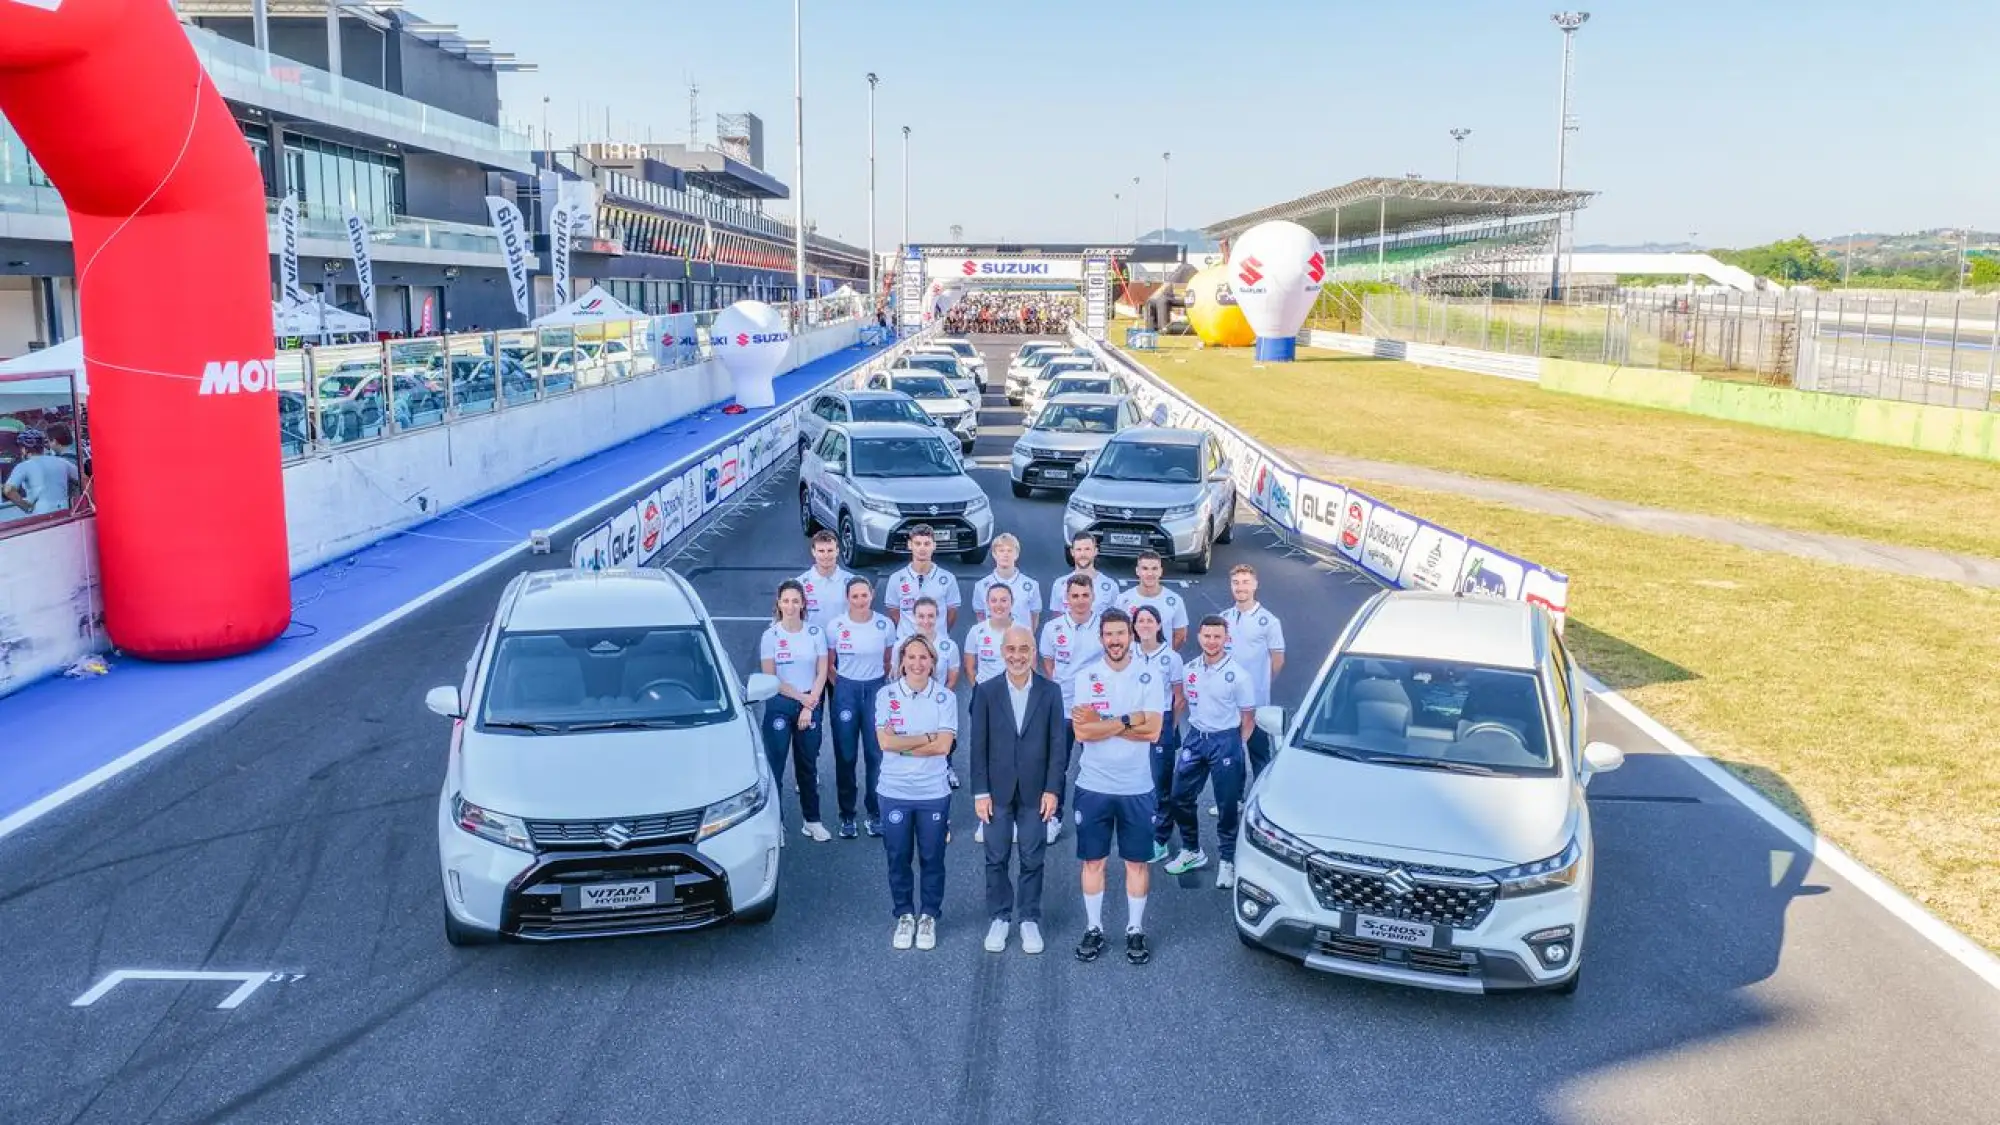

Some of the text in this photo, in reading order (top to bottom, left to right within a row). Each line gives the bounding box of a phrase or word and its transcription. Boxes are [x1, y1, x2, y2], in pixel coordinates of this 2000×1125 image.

[282, 206, 297, 283] vittoria
[554, 210, 568, 281] vittoria
[981, 263, 1048, 274] SUZUKI
[586, 885, 651, 898] VITARA
[595, 896, 643, 905] HYBRID
[1371, 929, 1419, 942] HYBRID
